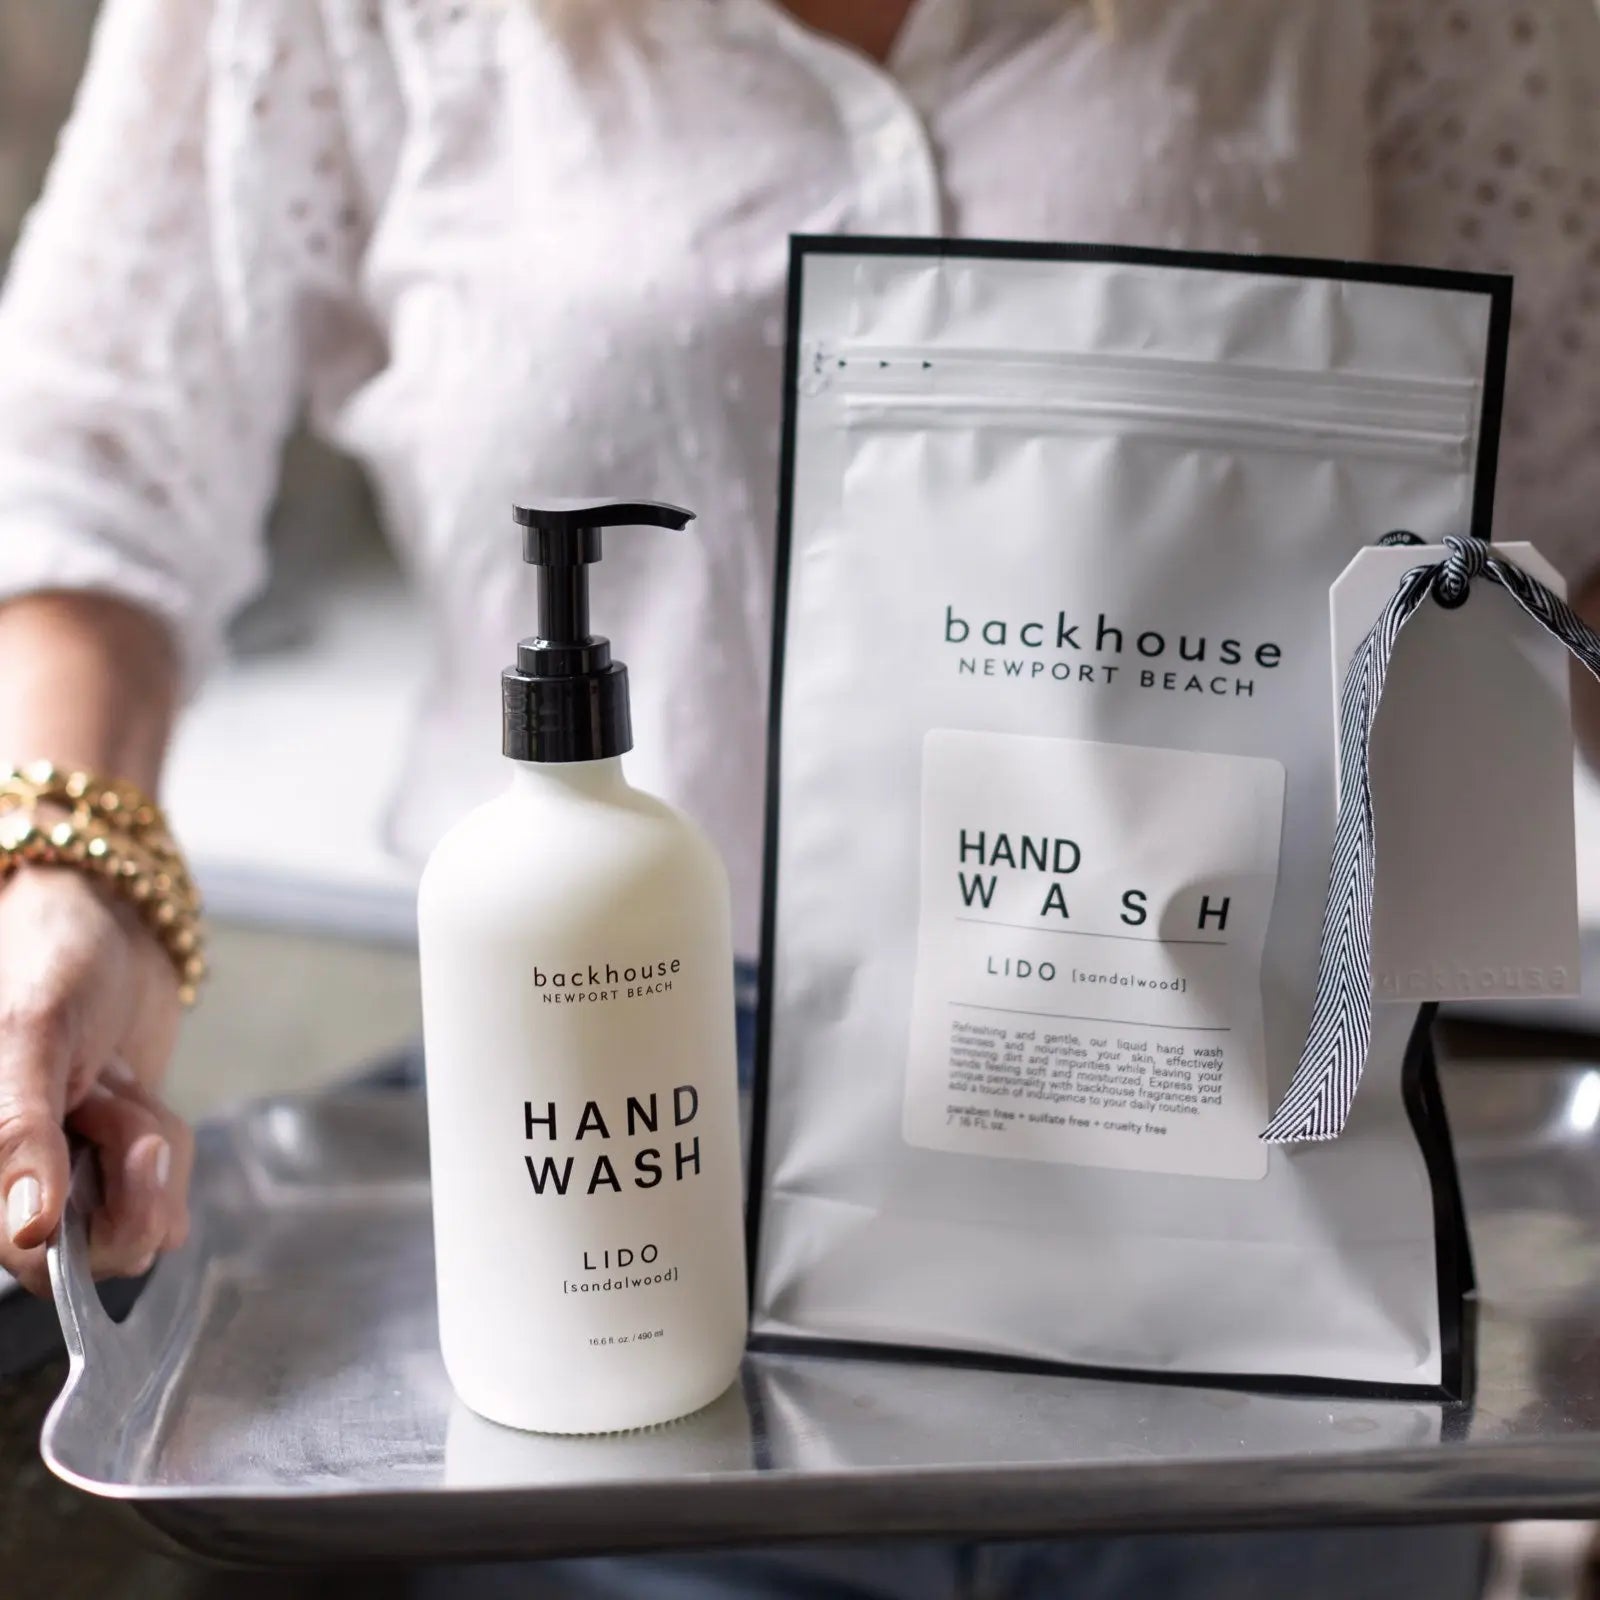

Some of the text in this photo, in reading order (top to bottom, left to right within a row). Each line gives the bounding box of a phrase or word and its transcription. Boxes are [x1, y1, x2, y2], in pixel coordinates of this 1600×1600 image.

[944, 605, 1282, 668] backhouse
[959, 657, 1255, 697] NEWPORT BEACH
[959, 829, 1081, 873] HAND
[534, 958, 681, 987] backhouse
[987, 956, 1187, 993] LIDO [sandalwood]
[542, 982, 673, 1004] NEWPORT BEACH
[952, 1020, 1006, 1039] Refreshing
[1015, 1030, 1036, 1040] and
[1090, 1038, 1107, 1047] our
[1117, 1038, 1147, 1052] liquid
[1156, 1043, 1184, 1055] hand
[1194, 1045, 1224, 1058] wash
[950, 1047, 1223, 1082] removing dirt and impurities while leaving your
[1004, 1041, 1024, 1051] and
[1034, 1045, 1088, 1057] nourishes
[1097, 1050, 1120, 1061] your
[1166, 1056, 1224, 1072] effectively
[950, 1071, 1223, 1105] unique personality with backhouse fragrances and
[985, 1060, 1021, 1076] feeling
[1026, 1066, 1046, 1076] soft
[1052, 1069, 1072, 1079] and
[1149, 1077, 1193, 1092] Express
[1198, 1084, 1222, 1094] your
[524, 1084, 699, 1140] HAND
[948, 1082, 1200, 1115] add a touch of indulgence to your daily routine.
[946, 1104, 991, 1117] paraben
[994, 1108, 1015, 1120] free
[1028, 1113, 1065, 1126] sulfate
[1068, 1115, 1090, 1128] free
[1103, 1120, 1142, 1135] cruelty
[1144, 1122, 1168, 1136] free
[524, 1136, 701, 1196] WASH
[584, 1244, 659, 1270] LIDO
[564, 1267, 679, 1294] [sandalwood]
[589, 1337, 607, 1346] 16.6
[618, 1336, 630, 1344] oz.
[637, 1330, 652, 1340] 490
[654, 1328, 664, 1338] ml
